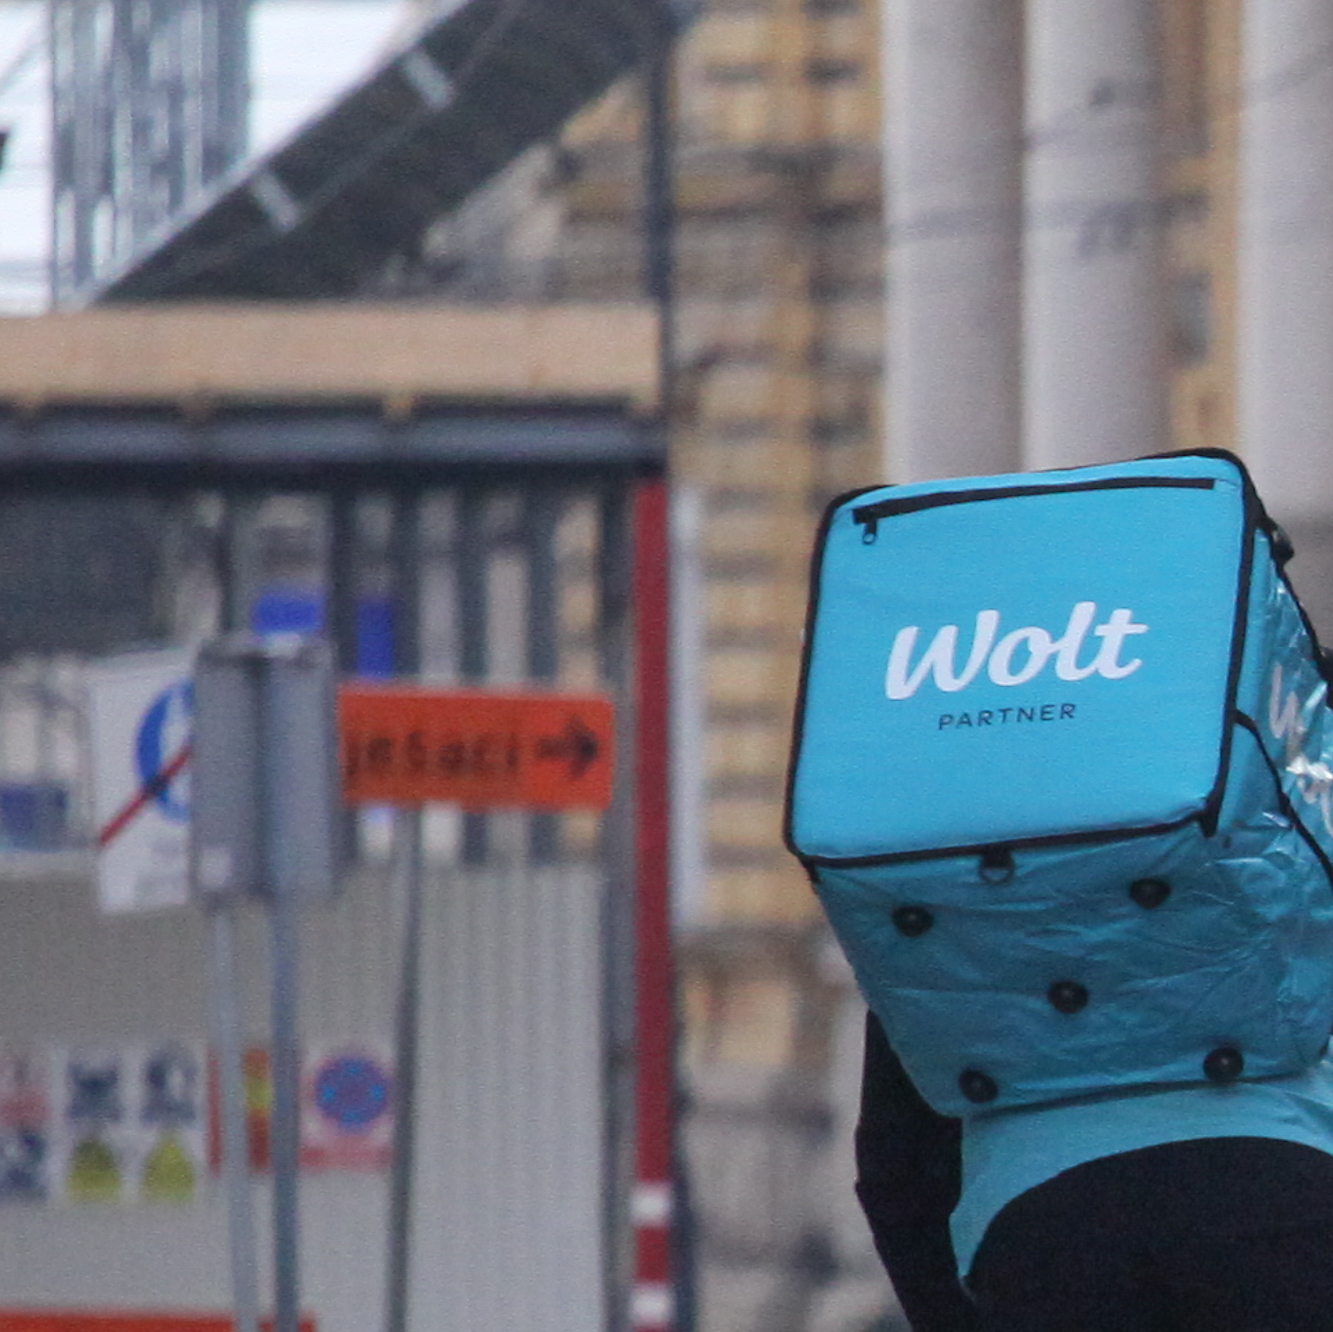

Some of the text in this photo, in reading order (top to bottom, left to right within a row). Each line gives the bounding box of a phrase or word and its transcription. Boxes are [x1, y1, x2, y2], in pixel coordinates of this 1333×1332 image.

[885, 600, 1149, 700] Wolt
[937, 703, 1077, 731] PARTNER
[346, 729, 520, 779] ješaci
